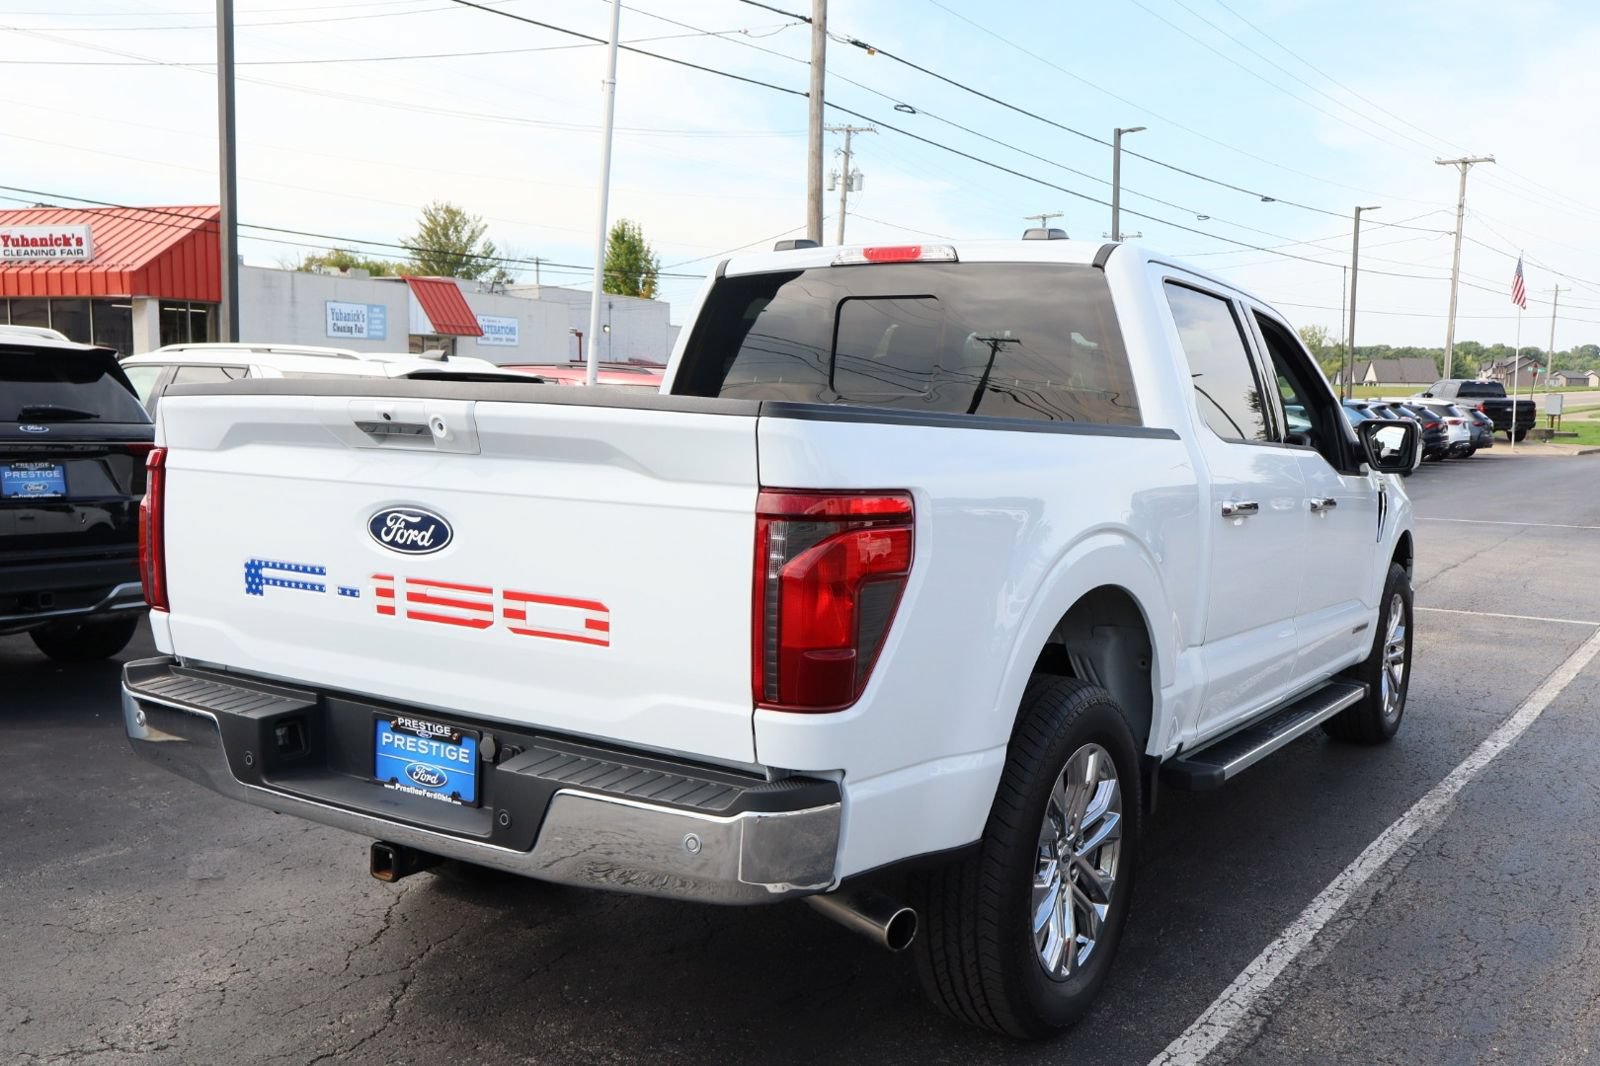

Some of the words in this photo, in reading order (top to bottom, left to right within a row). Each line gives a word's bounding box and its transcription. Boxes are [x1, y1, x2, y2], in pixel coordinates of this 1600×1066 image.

[1, 233, 83, 247] Yuhanick's
[3, 249, 56, 257] CLEANING
[4, 470, 61, 479] PRESTIGE
[381, 512, 435, 547] Ford
[245, 558, 610, 647] F-150
[397, 717, 451, 735] PRESTIGE
[382, 732, 470, 763] PRESTIGE
[412, 764, 439, 785] Ford
